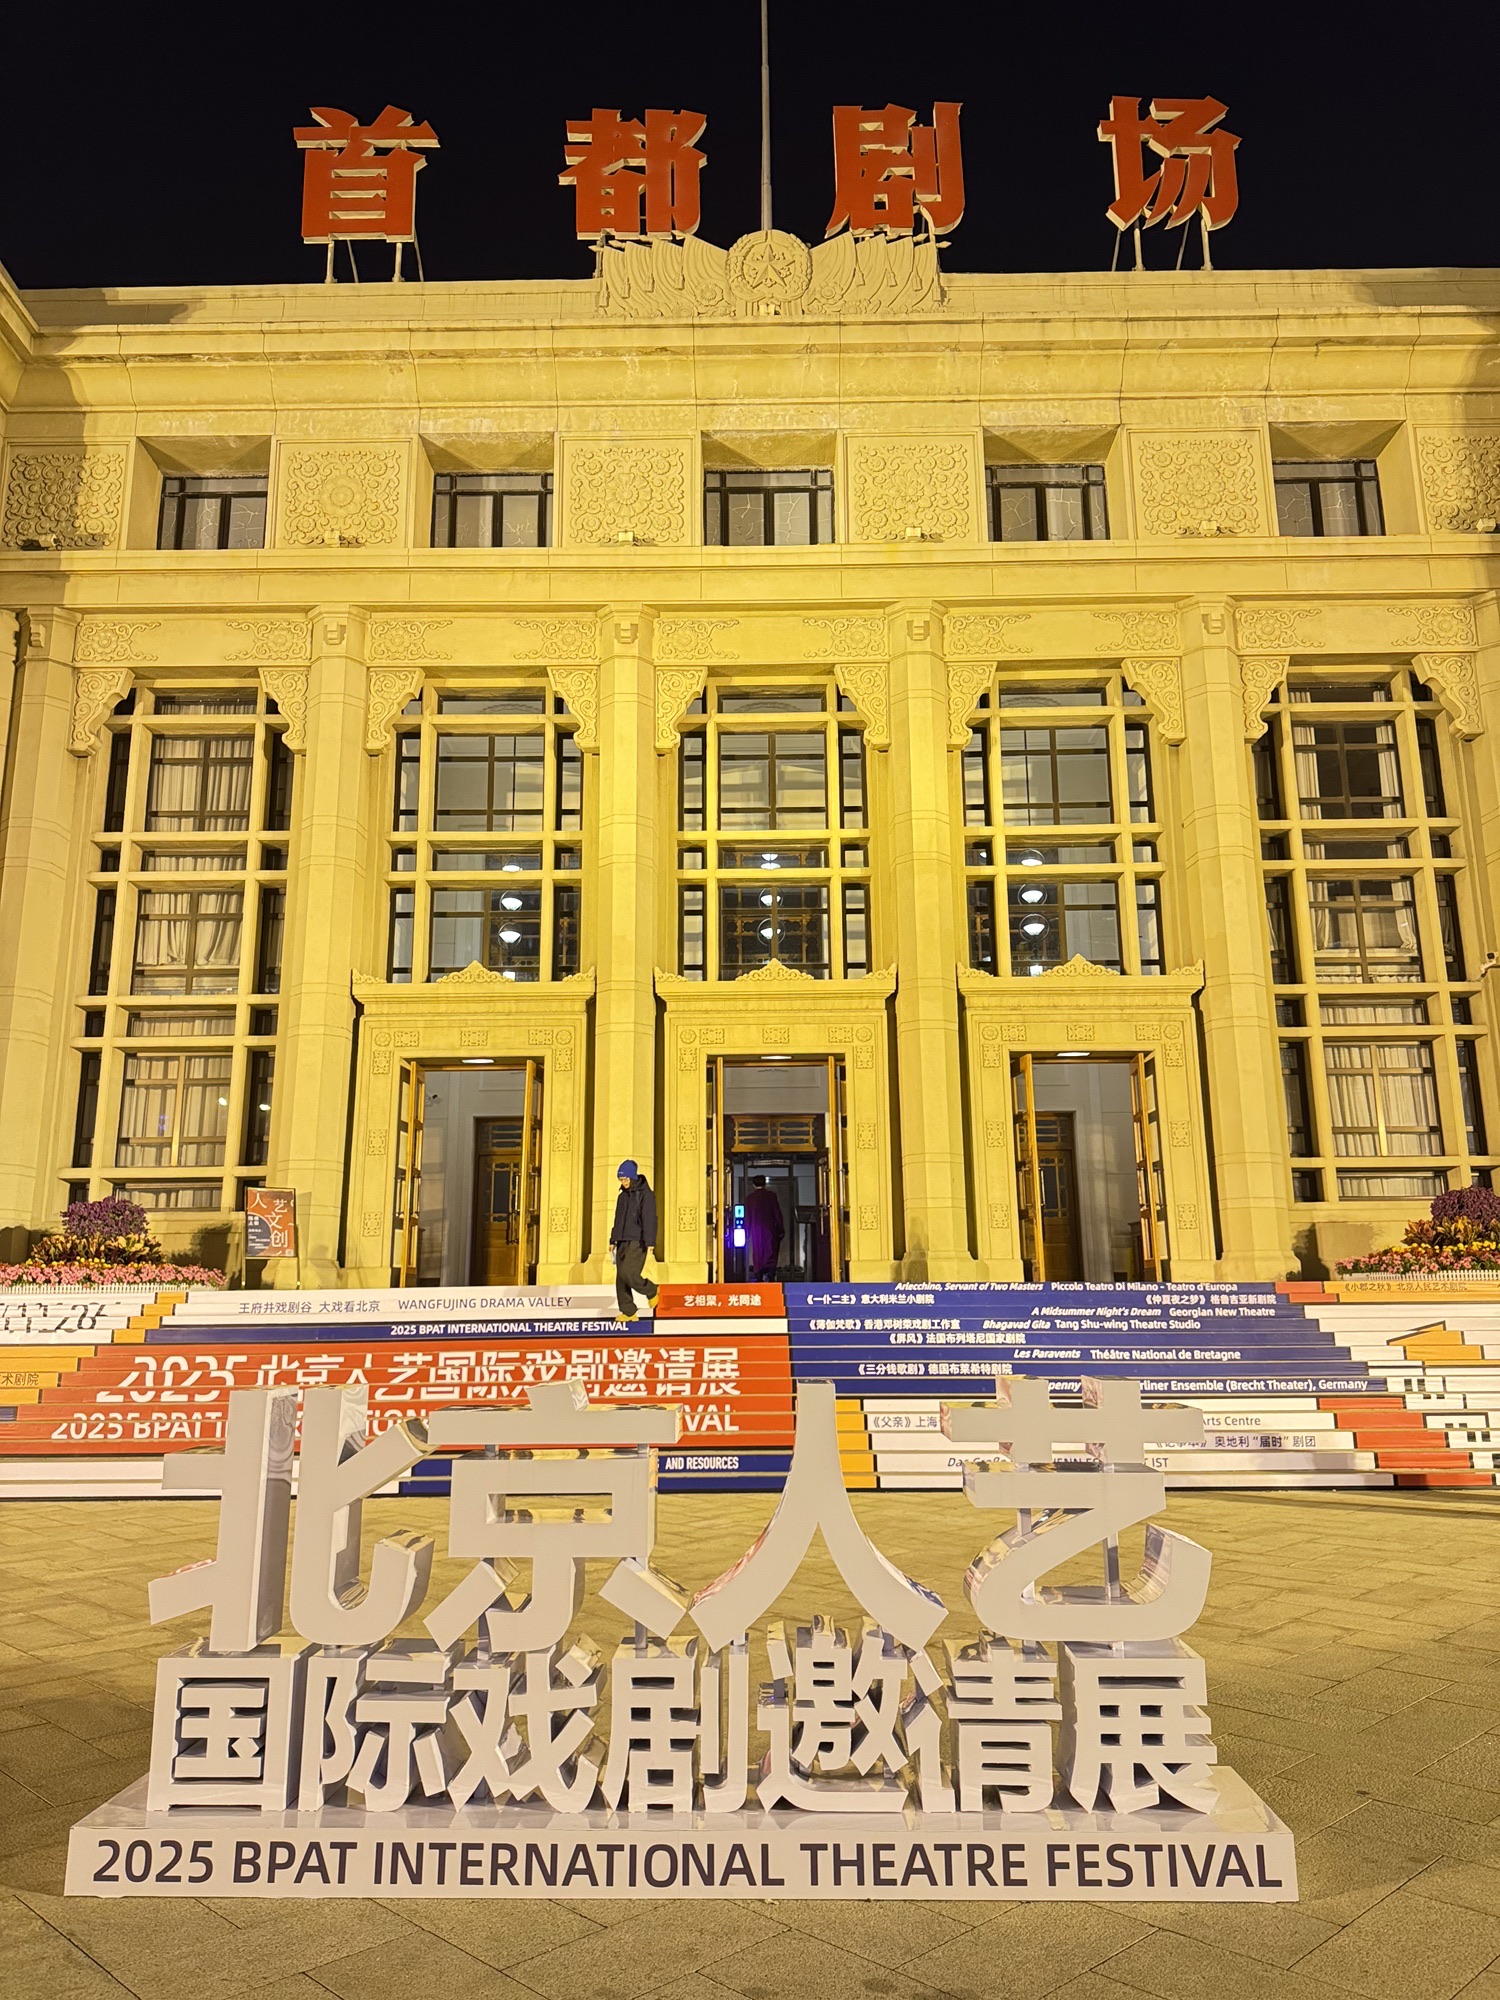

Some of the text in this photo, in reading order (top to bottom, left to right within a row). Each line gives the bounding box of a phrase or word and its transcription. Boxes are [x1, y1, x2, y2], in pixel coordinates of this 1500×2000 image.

[293, 95, 1241, 244] 首都剧场
[944, 1282, 978, 1292] Servant
[979, 1282, 989, 1291] of
[990, 1282, 1008, 1291] Two
[1009, 1282, 1044, 1292] Masters
[1051, 1282, 1084, 1292] Piccolo
[1085, 1282, 1114, 1292] Teatro
[1116, 1282, 1125, 1292] Di
[1127, 1282, 1159, 1292] Milano
[1166, 1282, 1196, 1292] Teatro
[239, 1301, 380, 1314] 王府井戏剧谷 大戏看北京
[398, 1297, 572, 1311] WANGFUJING DRAMA VALLEY
[1031, 1307, 1039, 1316] A
[1041, 1307, 1095, 1316] Midsummer
[1130, 1307, 1162, 1317] Dream
[1169, 1307, 1213, 1319] Georgian
[1215, 1307, 1237, 1317] New
[1238, 1307, 1276, 1317] Theatre
[390, 1321, 629, 1335] 2025 BPAT INTERNATIONAL THEATRE FESTIVAL
[983, 1319, 1201, 1331] Bhagavad Gita Tang Shu-wing Theatre Studio
[1014, 1349, 1030, 1358] Les
[1032, 1349, 1081, 1359] Paravents
[1131, 1349, 1177, 1359] National
[1178, 1349, 1192, 1359] de
[1193, 1349, 1241, 1361] Bretagne
[0, 1373, 39, 1386] 术剧院
[1171, 1380, 1223, 1391] Ensemble
[1226, 1380, 1265, 1393] (Brecht
[1267, 1380, 1317, 1392] Theater),
[1319, 1380, 1368, 1393] Germany
[1224, 1416, 1261, 1426] Centre
[665, 1457, 684, 1470] AND
[687, 1456, 739, 1470] RESOURCES
[149, 1377, 1212, 1653] 北京人艺
[147, 1632, 1221, 1814] 国际戏剧邀请展
[93, 1839, 1283, 1888] 2025 BPAT INTERNATIONAL THEATRE FESTIVAL
